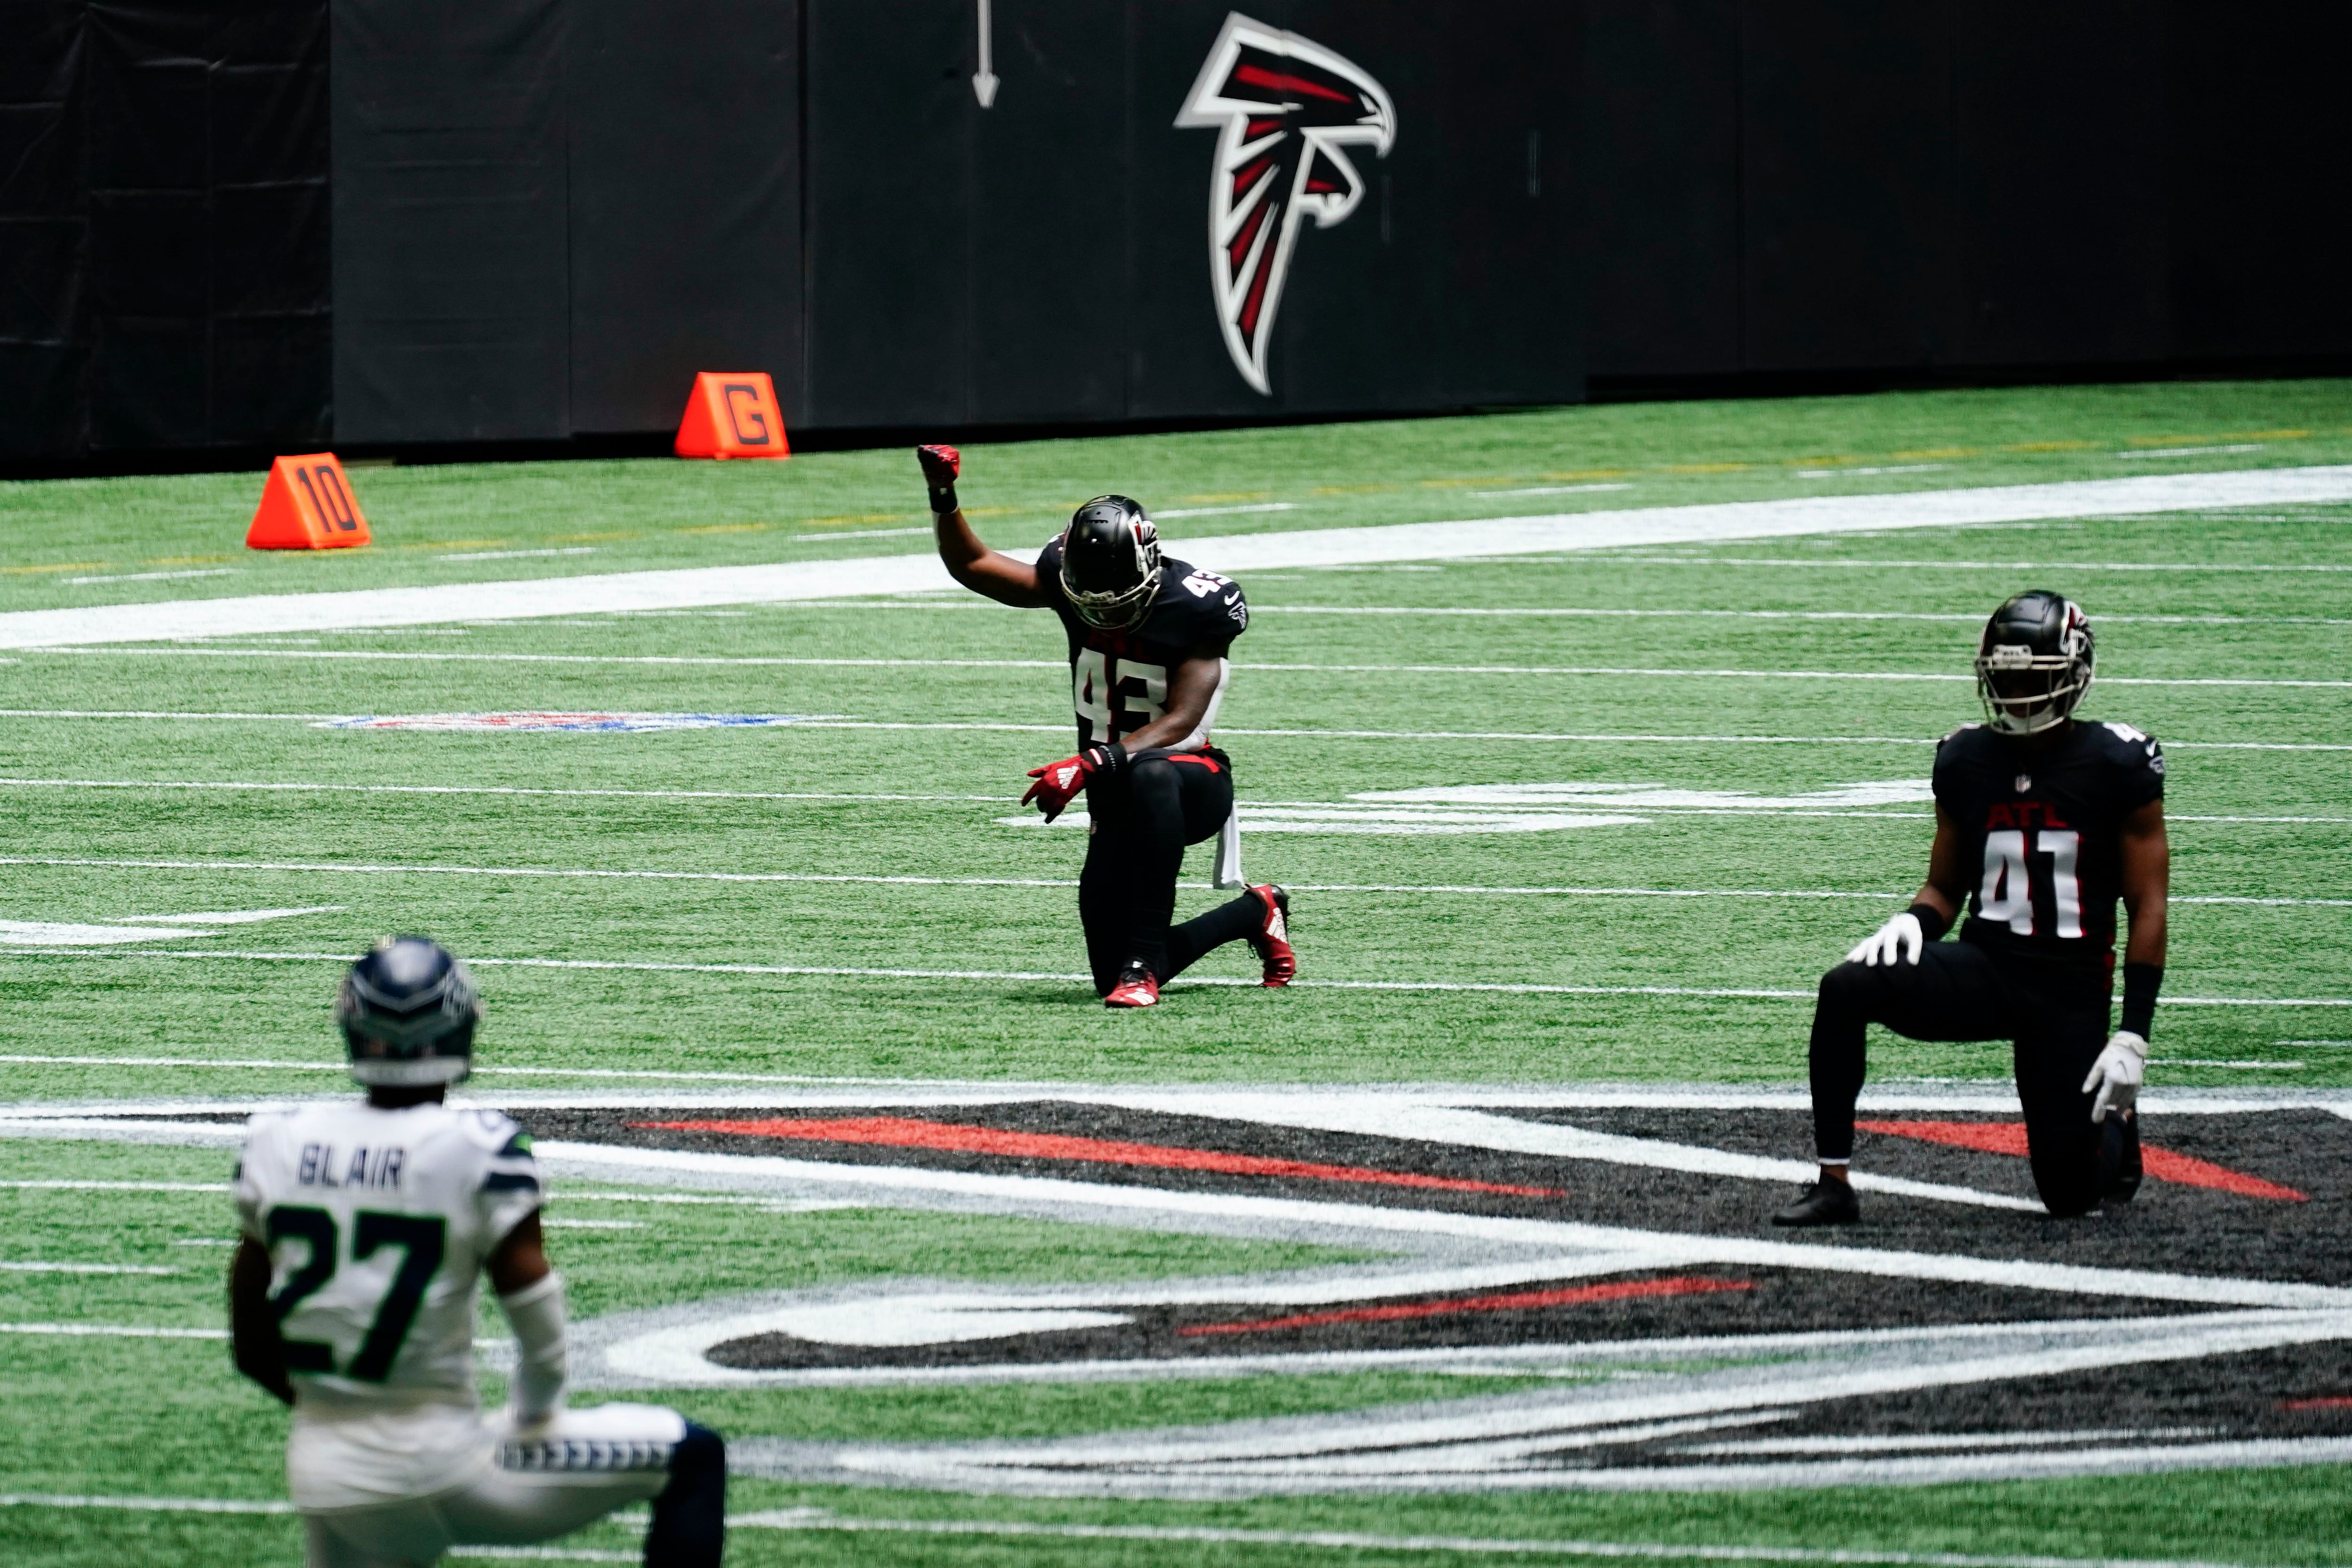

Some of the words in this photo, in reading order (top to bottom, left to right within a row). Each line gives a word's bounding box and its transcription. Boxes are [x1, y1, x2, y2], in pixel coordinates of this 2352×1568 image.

[724, 384, 770, 445] G
[297, 465, 358, 533] 10
[1181, 568, 1234, 598] 43
[1074, 646, 1170, 744] 43
[2103, 722, 2148, 742] 4
[1983, 801, 2071, 829] ATL
[1977, 829, 2088, 939] 41
[296, 1144, 405, 1191] BLAIR
[267, 1205, 446, 1382] 27
